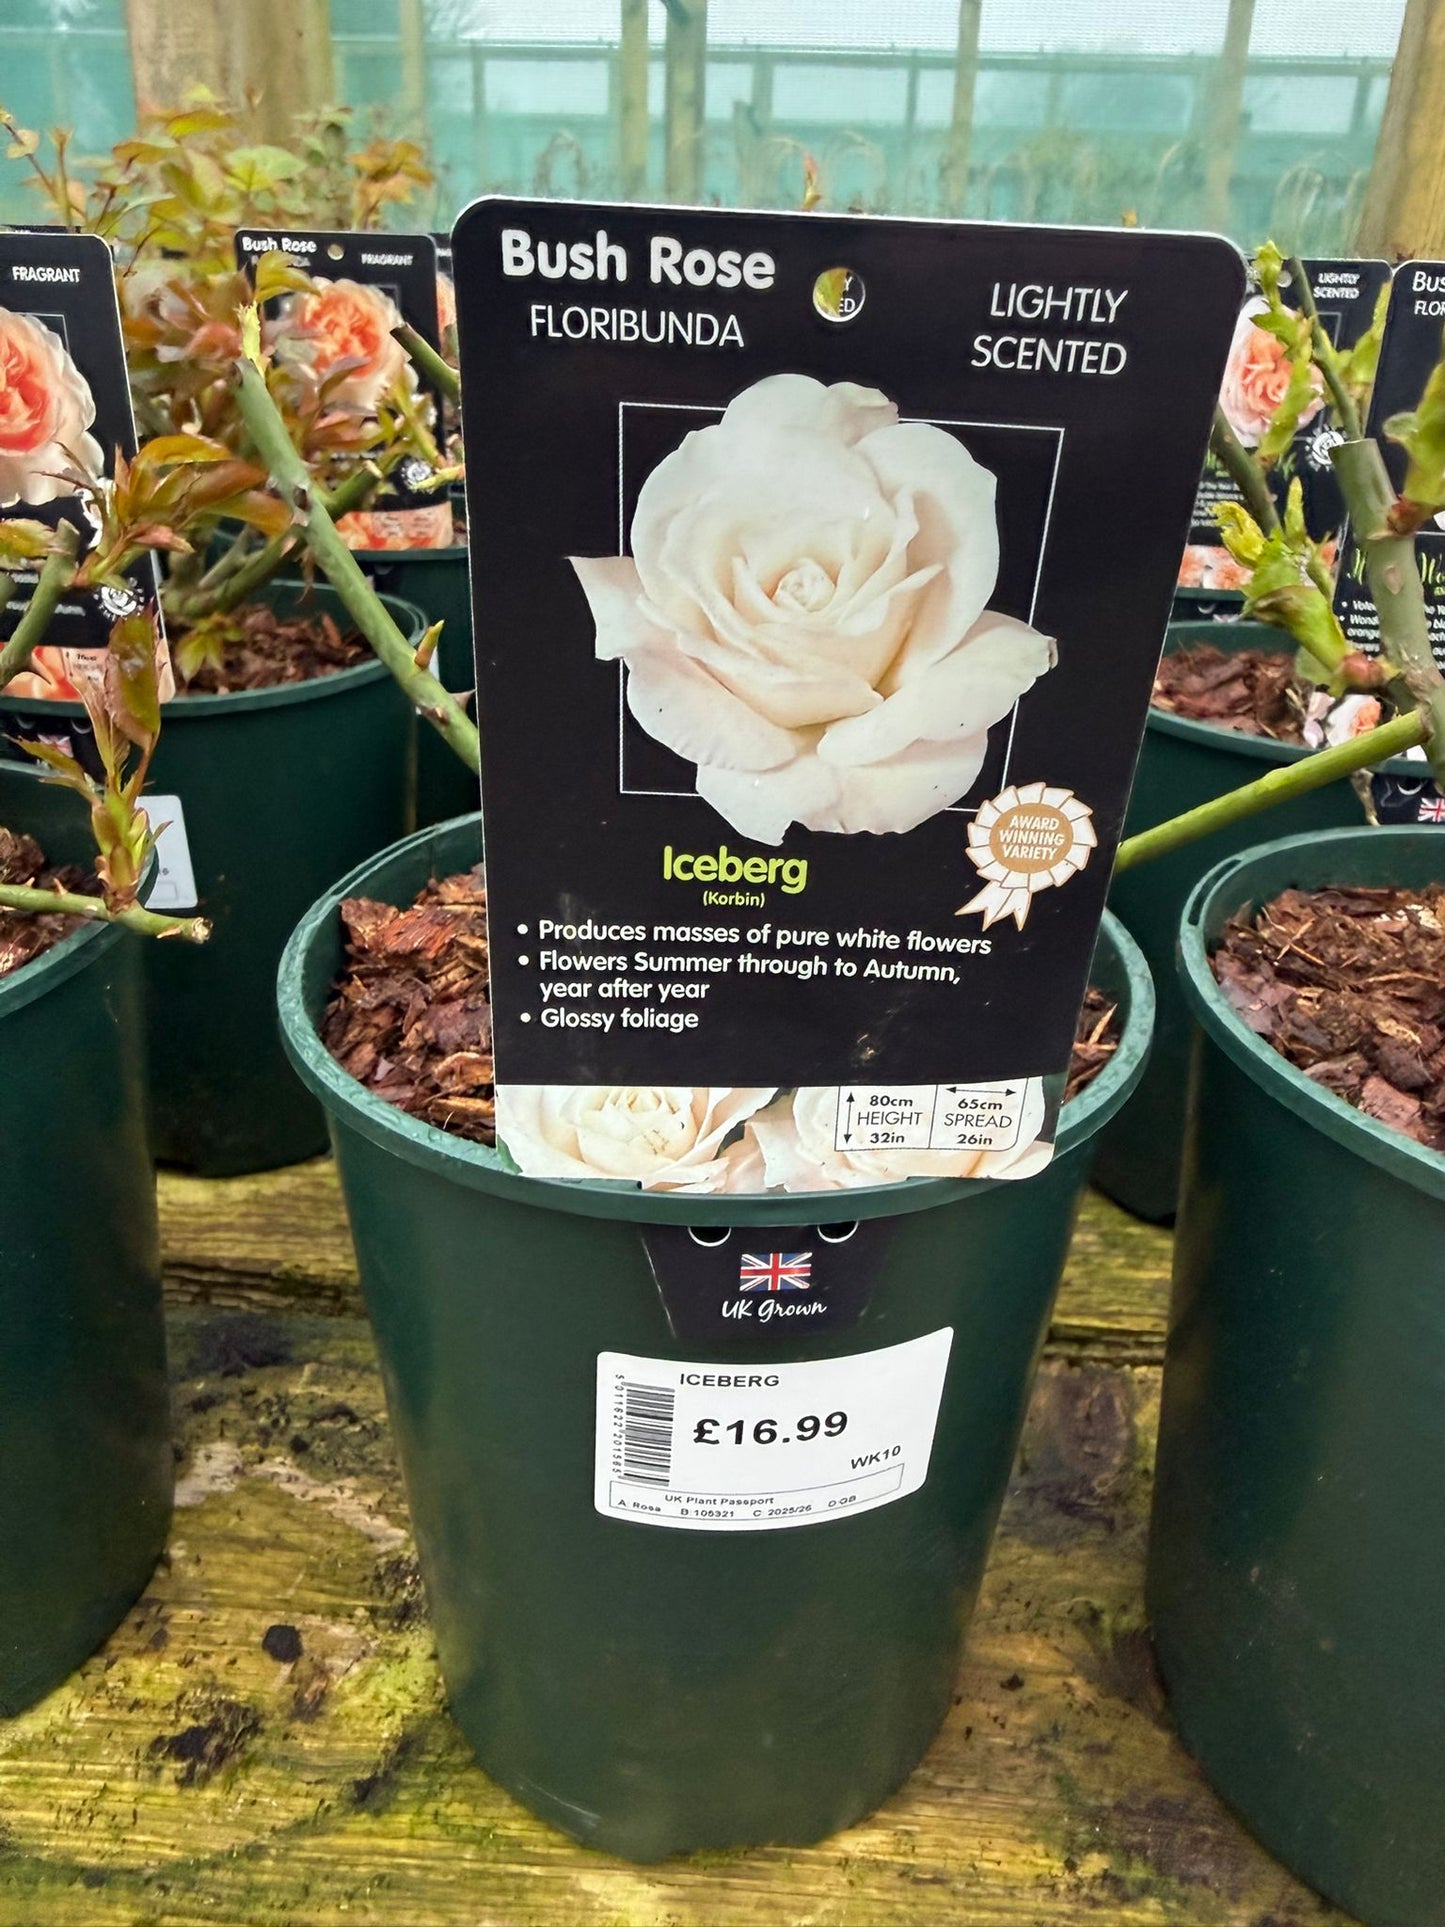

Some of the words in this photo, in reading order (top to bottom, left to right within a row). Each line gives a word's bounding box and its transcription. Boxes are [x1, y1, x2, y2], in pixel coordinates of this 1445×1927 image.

[242, 236, 278, 251] Bush
[281, 237, 317, 253] Rose
[501, 229, 628, 282] Bush
[650, 236, 776, 289] Rose
[12, 266, 80, 283] FRAGRANT
[989, 282, 1128, 324] LIGHTLY
[530, 304, 745, 348] FLORIBUNDA
[971, 335, 1128, 376] SCENTED
[1009, 815, 1060, 830] AWARD
[999, 828, 1066, 846] WINNING
[1002, 844, 1058, 860] VARIETY
[663, 845, 808, 894] Iceberg
[703, 890, 765, 908] (Korbin)
[539, 918, 646, 940] Produces
[653, 925, 740, 942] masses
[746, 923, 772, 944] of
[776, 928, 830, 949] pure
[836, 927, 901, 950] white
[906, 930, 992, 954] flowers
[540, 950, 628, 971] Flowers
[634, 952, 732, 972] Summer
[738, 952, 828, 980] through
[834, 958, 857, 977] to
[863, 959, 961, 985] Autumn,
[540, 982, 592, 1002] year
[598, 978, 652, 998] after
[658, 983, 710, 1003] year
[540, 1006, 615, 1033] Glossy
[620, 1006, 699, 1034] foliage
[869, 1095, 913, 1108] 80cm
[958, 1098, 1003, 1111] 65cm
[857, 1111, 923, 1126] HEIGHT
[943, 1113, 1012, 1129] SPREAD
[870, 1132, 905, 1144] 32in
[956, 1134, 993, 1146] 26in
[721, 1299, 753, 1320] UK
[758, 1298, 827, 1323] Grown
[680, 1373, 780, 1388] ICEBERG
[693, 1411, 848, 1445] £16.99
[850, 1445, 901, 1469] WK10
[632, 1502, 662, 1512] Rosa
[664, 1494, 682, 1503] UK
[686, 1496, 717, 1506] Plant
[720, 1498, 774, 1507] Passport
